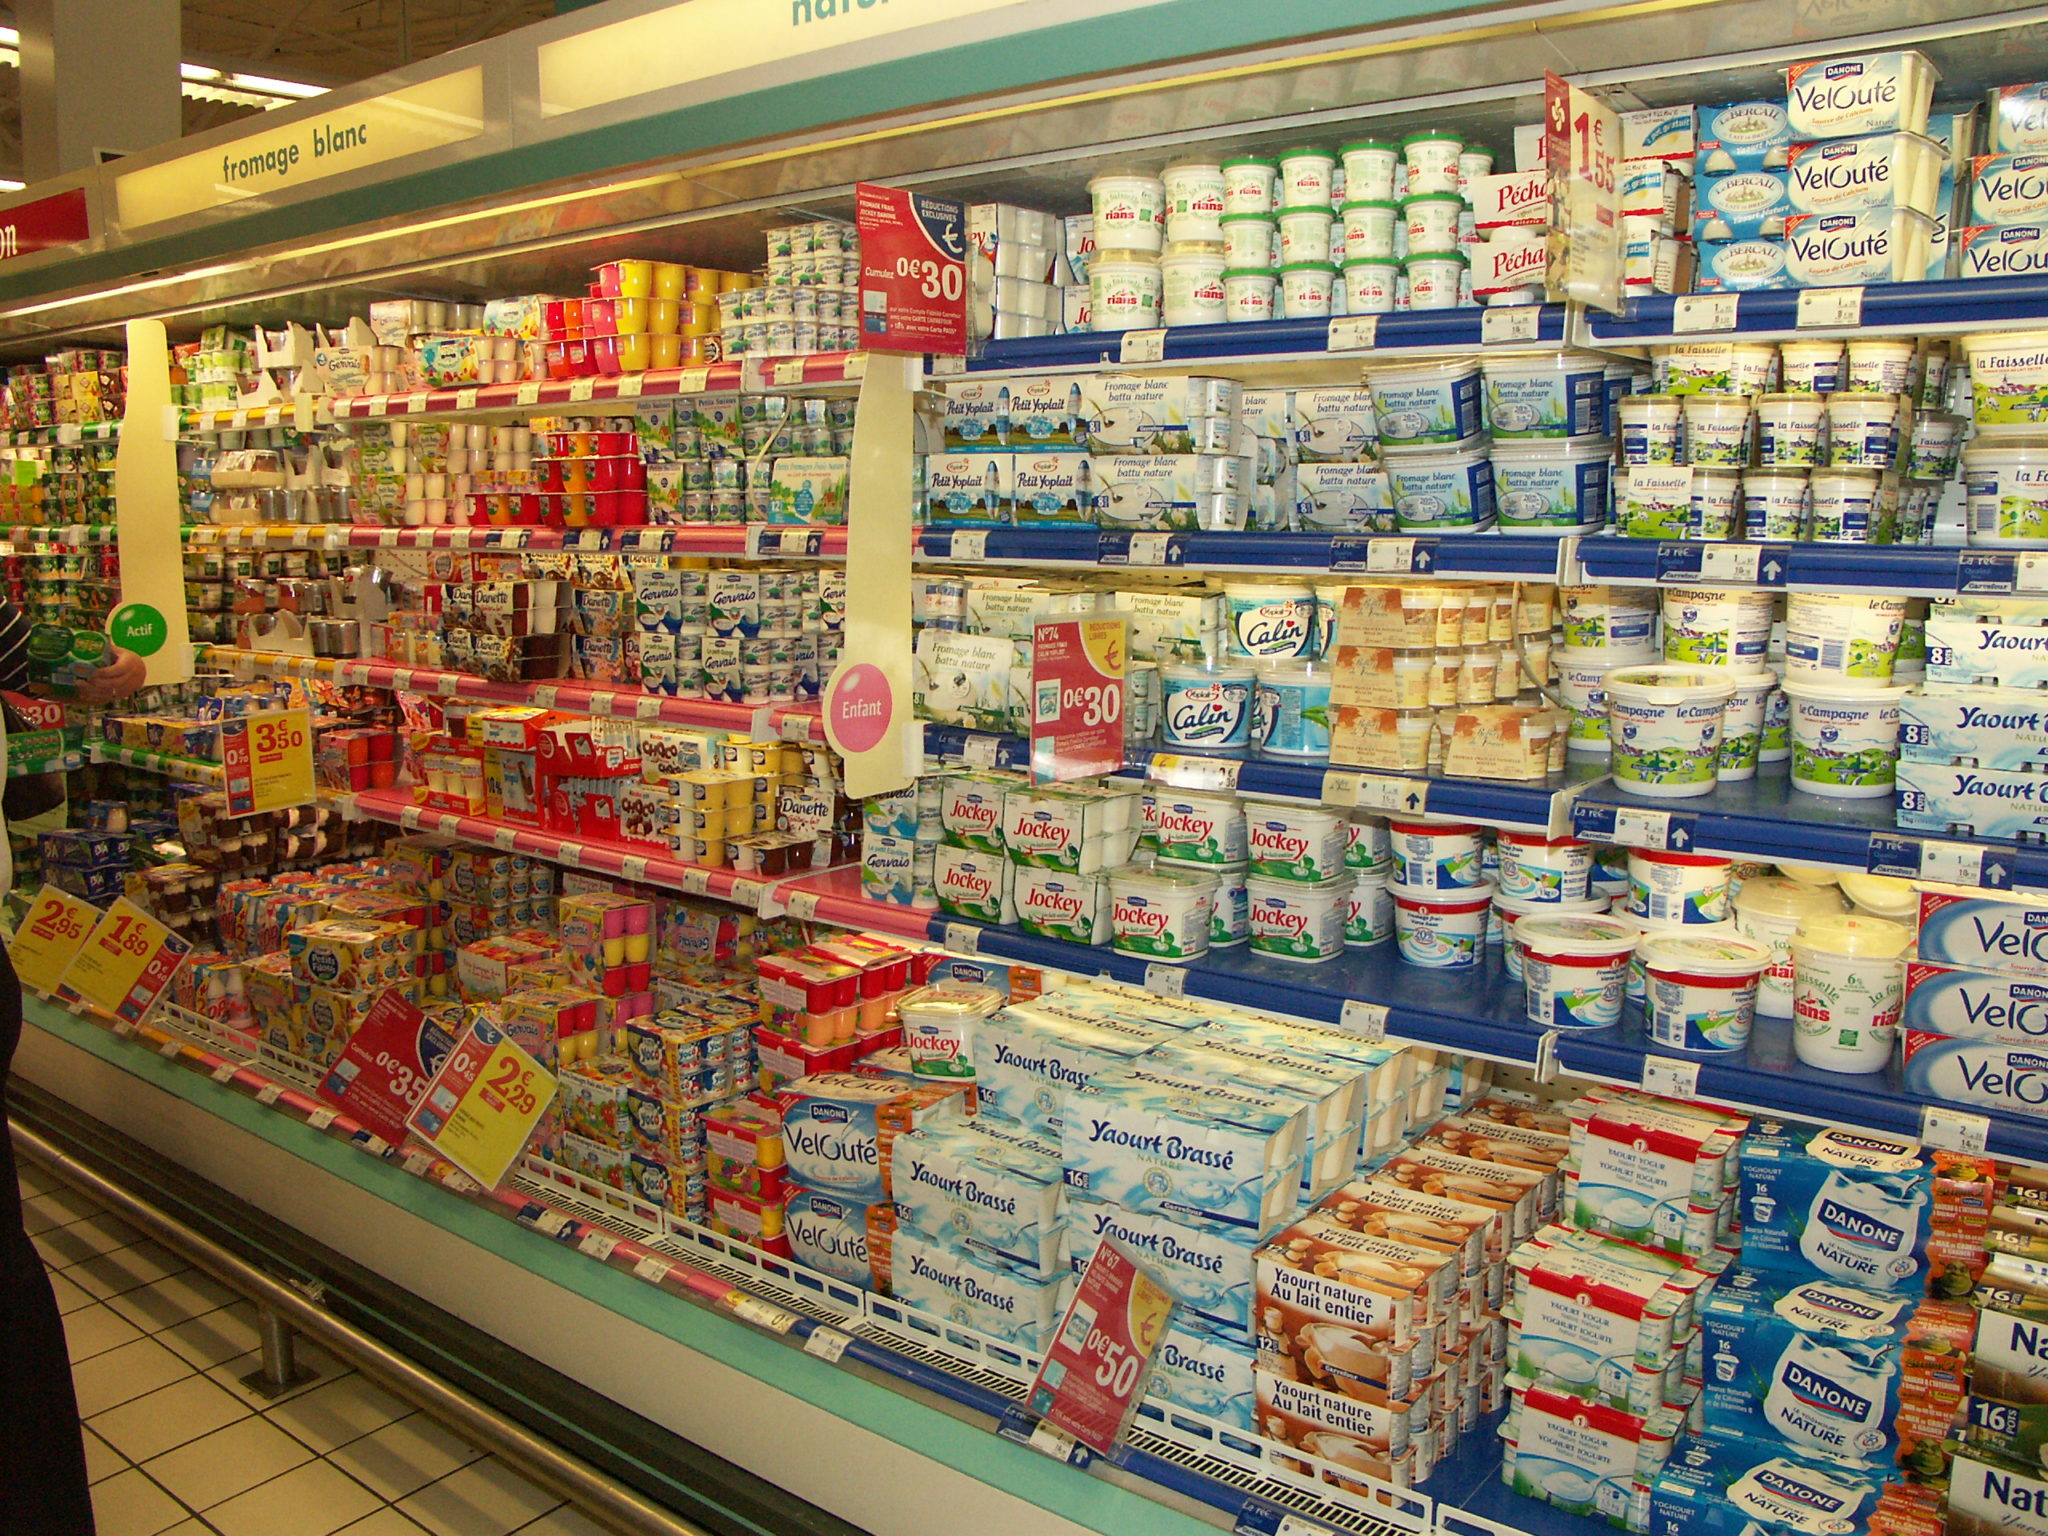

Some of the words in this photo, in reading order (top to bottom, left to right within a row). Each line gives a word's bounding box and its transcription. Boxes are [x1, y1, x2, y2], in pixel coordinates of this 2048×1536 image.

[1866, 118, 1896, 127] Nature
[223, 139, 299, 182] fromage
[313, 124, 367, 157] blanc
[1105, 209, 1134, 220] rians
[1192, 201, 1223, 211] rians
[921, 209, 957, 223] EXCLUSIVES
[865, 266, 894, 279] Cumulez
[1107, 296, 1137, 305] rians
[1194, 289, 1224, 300] rians
[1104, 381, 1141, 393] Fromage
[1144, 381, 1169, 390] blanc
[1108, 391, 1133, 401] battu
[1136, 392, 1164, 401] nature
[946, 400, 965, 415] Petit
[965, 400, 994, 416] Yoplait
[1011, 396, 1031, 411] Petit
[1032, 396, 1065, 412] Yoplait
[1114, 458, 1151, 469] Fromage
[1154, 457, 1178, 467] blanc
[1316, 466, 1353, 476] Fromage
[1356, 464, 1380, 474] blanc
[931, 473, 950, 488] Petit
[951, 473, 982, 489] Yoplait
[1017, 473, 1038, 488] Petit
[1039, 473, 1073, 489] Yoplait
[1117, 468, 1141, 478] battu
[1143, 468, 1173, 478] nature
[1634, 478, 1643, 487] la
[1646, 478, 1686, 488] Faisselle
[475, 590, 508, 605] Danette
[582, 596, 611, 608] Danette
[640, 586, 679, 601] Gervais
[713, 591, 756, 606] Gervais
[126, 623, 153, 637] Actif
[1247, 622, 1303, 647] Calin
[583, 640, 613, 654] Danette
[932, 643, 969, 658] Fromage
[972, 646, 997, 659] blanc
[643, 652, 672, 663] Gervais
[704, 657, 737, 671] Gervais
[935, 655, 958, 666] battu
[961, 658, 991, 671] nature
[842, 700, 882, 718] Enfant
[1174, 704, 1233, 729] Calin
[1956, 707, 2039, 731] Yaourt
[642, 740, 678, 760] CHOCO
[1952, 774, 2035, 799] Yaourt
[621, 798, 656, 817] CHOCO
[783, 797, 830, 817] Danette
[1902, 792, 1914, 809] 8
[950, 800, 997, 829] Jockey
[1013, 817, 1070, 849] Jockey
[1158, 813, 1213, 843] Jockey
[1250, 832, 1308, 863] Jockey
[867, 854, 910, 868] Gervais
[943, 868, 991, 900] Jockey
[1025, 888, 1083, 921] Jockey
[1113, 903, 1169, 936] Jockey
[1250, 908, 1308, 938] Jockey
[909, 1032, 960, 1060] Jockey
[994, 1044, 1047, 1074] Yaourt
[1049, 1058, 1097, 1085] Brass
[813, 1106, 847, 1120] DANONE
[1089, 1119, 1163, 1152] Yaourt
[1166, 1136, 1234, 1171] Brassé
[1830, 1131, 1903, 1154] DANONE
[1821, 1147, 1882, 1167] NATURE
[911, 1160, 963, 1195] Yaourt
[967, 1183, 1016, 1216] Brassé
[2013, 1186, 2038, 1200] 16
[811, 1200, 843, 1216] DANONE
[1823, 1202, 1901, 1246] DANONE
[1093, 1213, 1159, 1250] Yaourt
[1162, 1236, 1224, 1274] Brassé
[1313, 1231, 1334, 1242] Au
[1336, 1235, 1361, 1250] lait
[1365, 1243, 1416, 1263] entier
[1993, 1232, 2018, 1245] 16
[1816, 1241, 1880, 1276] NATURE
[910, 1254, 961, 1293] Yaourt
[965, 1278, 1014, 1314] Brassé
[1274, 1267, 1321, 1295] Yaourt
[1323, 1285, 1373, 1309] nature
[1984, 1287, 2009, 1301] 16
[1270, 1283, 1292, 1302] Au
[1295, 1290, 1322, 1315] lait
[1325, 1300, 1374, 1325] entier
[1805, 1289, 1880, 1319] DANONE
[1705, 1320, 1746, 1334] YOGHOURT
[1790, 1304, 1853, 1332] NATURE
[1258, 1336, 1272, 1350] 12
[1164, 1344, 1225, 1383] Brassé
[1273, 1378, 1320, 1406] Yaourt
[1323, 1397, 1372, 1421] nature
[1788, 1366, 1868, 1416] DANONE
[1271, 1393, 1294, 1411] Au
[1296, 1400, 1322, 1422] lait
[1325, 1412, 1375, 1437] entier
[1976, 1403, 2006, 1431] 16
[2007, 1409, 2017, 1435] POTS
[1780, 1406, 1846, 1448] NATURE
[1760, 1472, 1840, 1510] DANONE
[1653, 1499, 1696, 1517] YOGHOURT
[1743, 1492, 1810, 1525] NATURE
